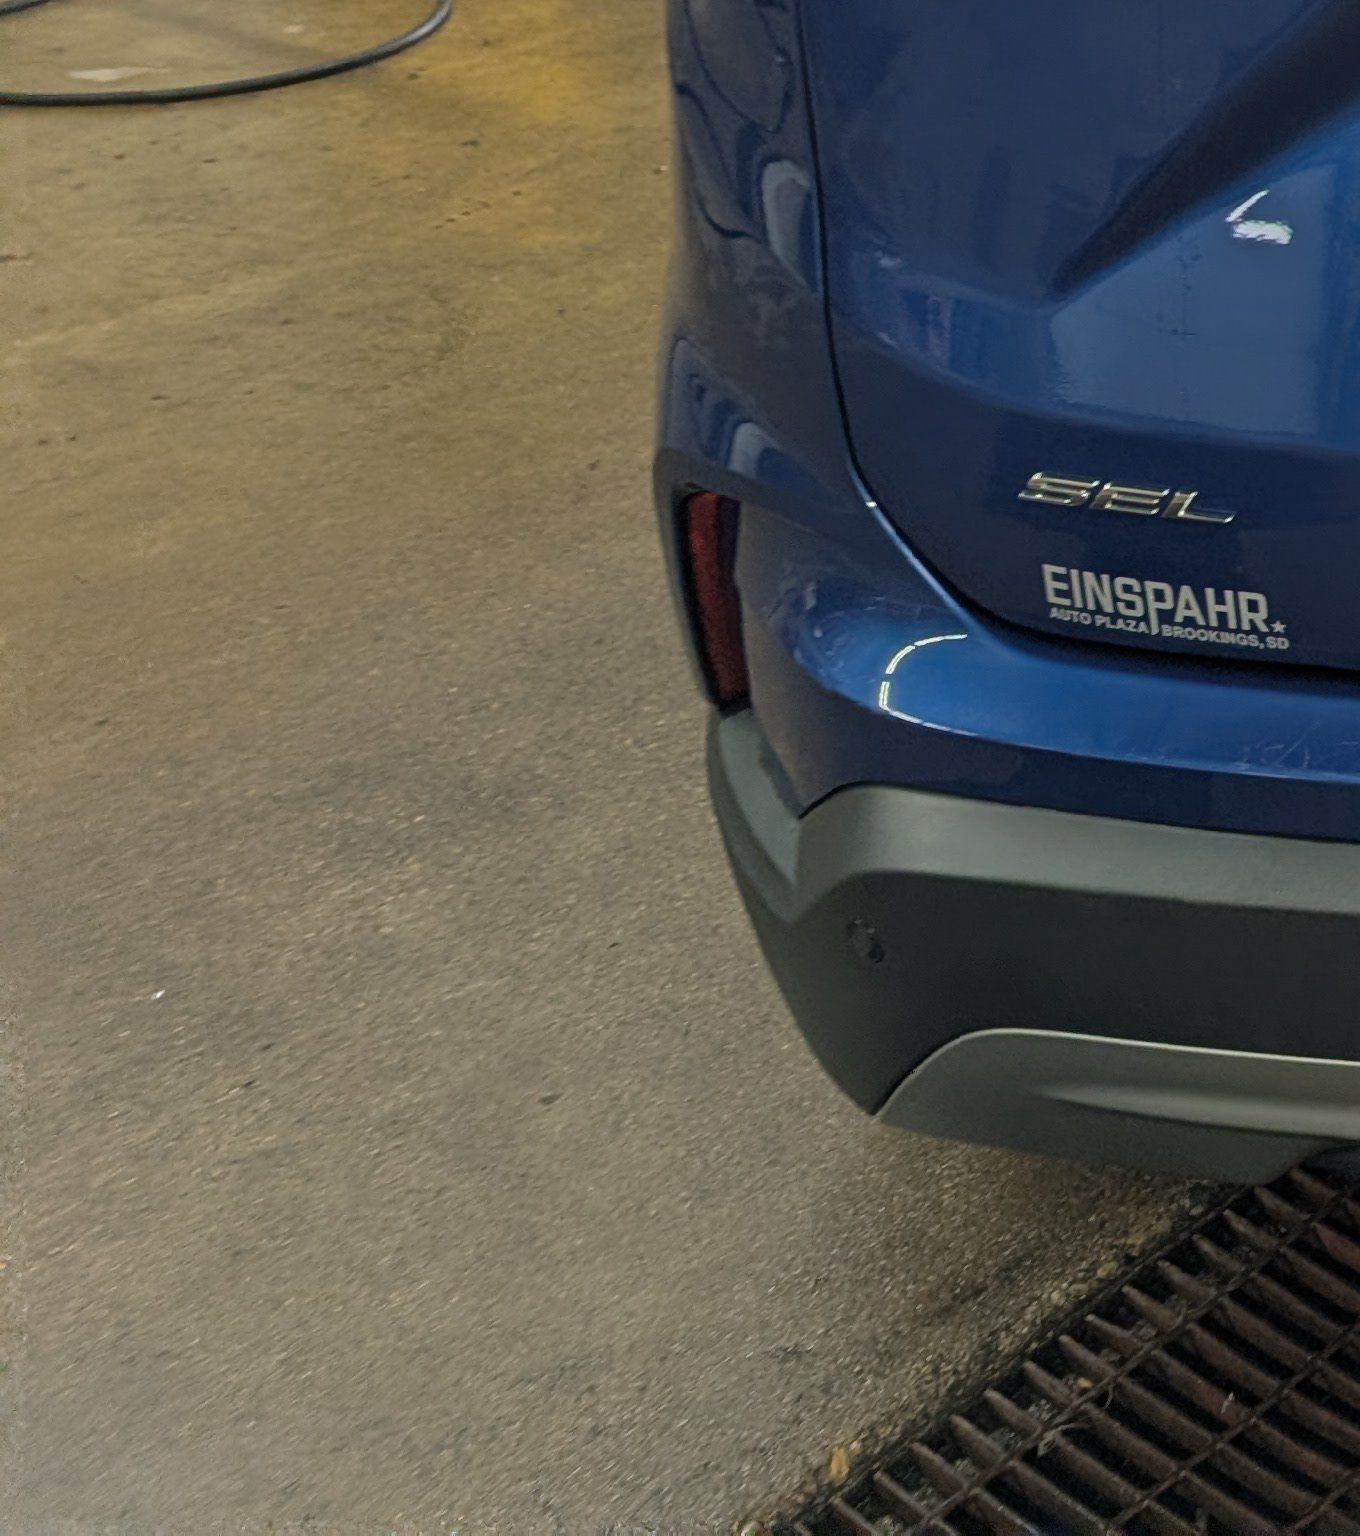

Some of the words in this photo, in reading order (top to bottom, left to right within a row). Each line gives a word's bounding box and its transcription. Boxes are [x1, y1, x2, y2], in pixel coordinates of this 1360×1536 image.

[1016, 471, 1238, 525] SEL
[1041, 563, 1271, 636] EINSPAHR
[1048, 606, 1092, 626] AUTO
[1094, 615, 1149, 635] PLAZA
[1161, 624, 1264, 650] BROOKINGS,
[1265, 636, 1290, 651] SD
